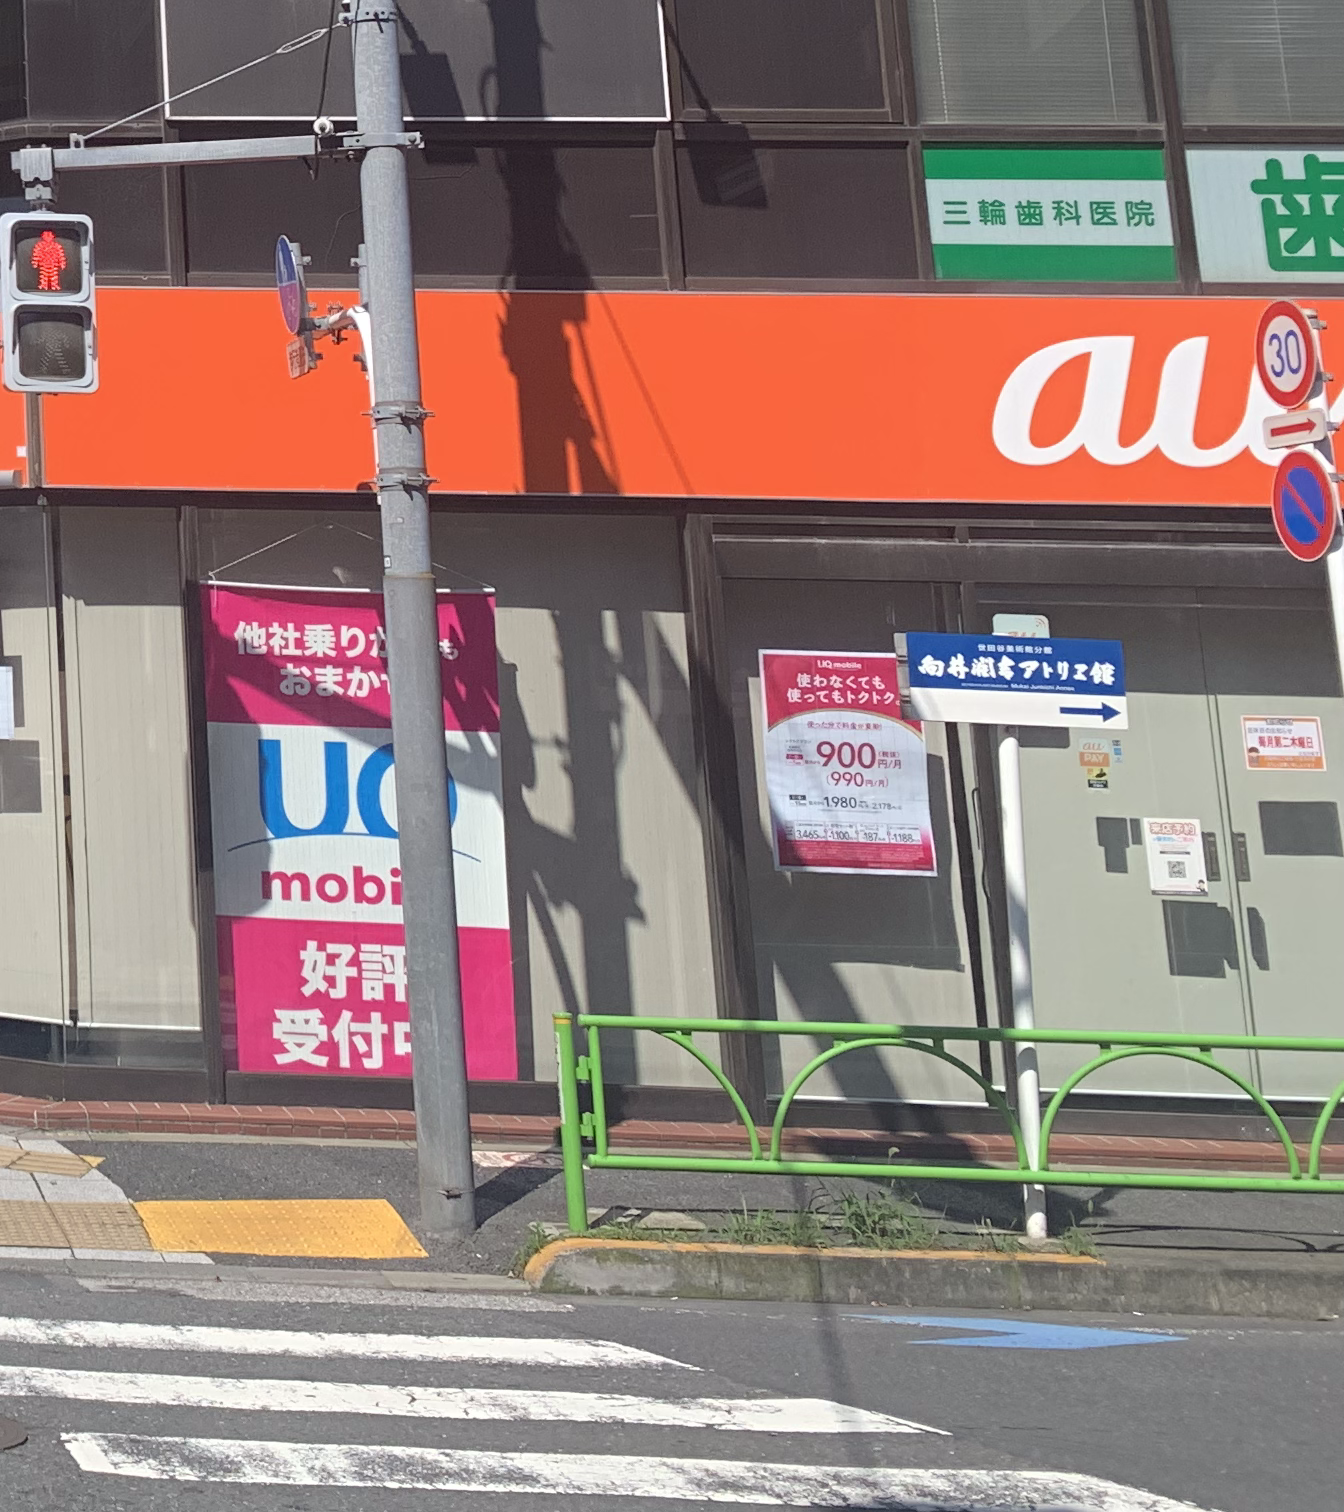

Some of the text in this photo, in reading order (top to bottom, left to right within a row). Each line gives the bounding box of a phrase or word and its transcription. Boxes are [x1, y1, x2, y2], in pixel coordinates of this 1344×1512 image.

[942, 199, 1156, 228] 三輪歯科医院
[1267, 329, 1302, 378] 30
[991, 335, 1344, 468] au
[977, 643, 1053, 655] 世田谷美術館分館
[833, 661, 862, 671] mobile
[796, 672, 886, 690] 使わなくても
[816, 740, 877, 769] 900
[1083, 742, 1106, 751] au
[1084, 753, 1105, 763] PAY
[1150, 822, 1196, 836] 来店予約
